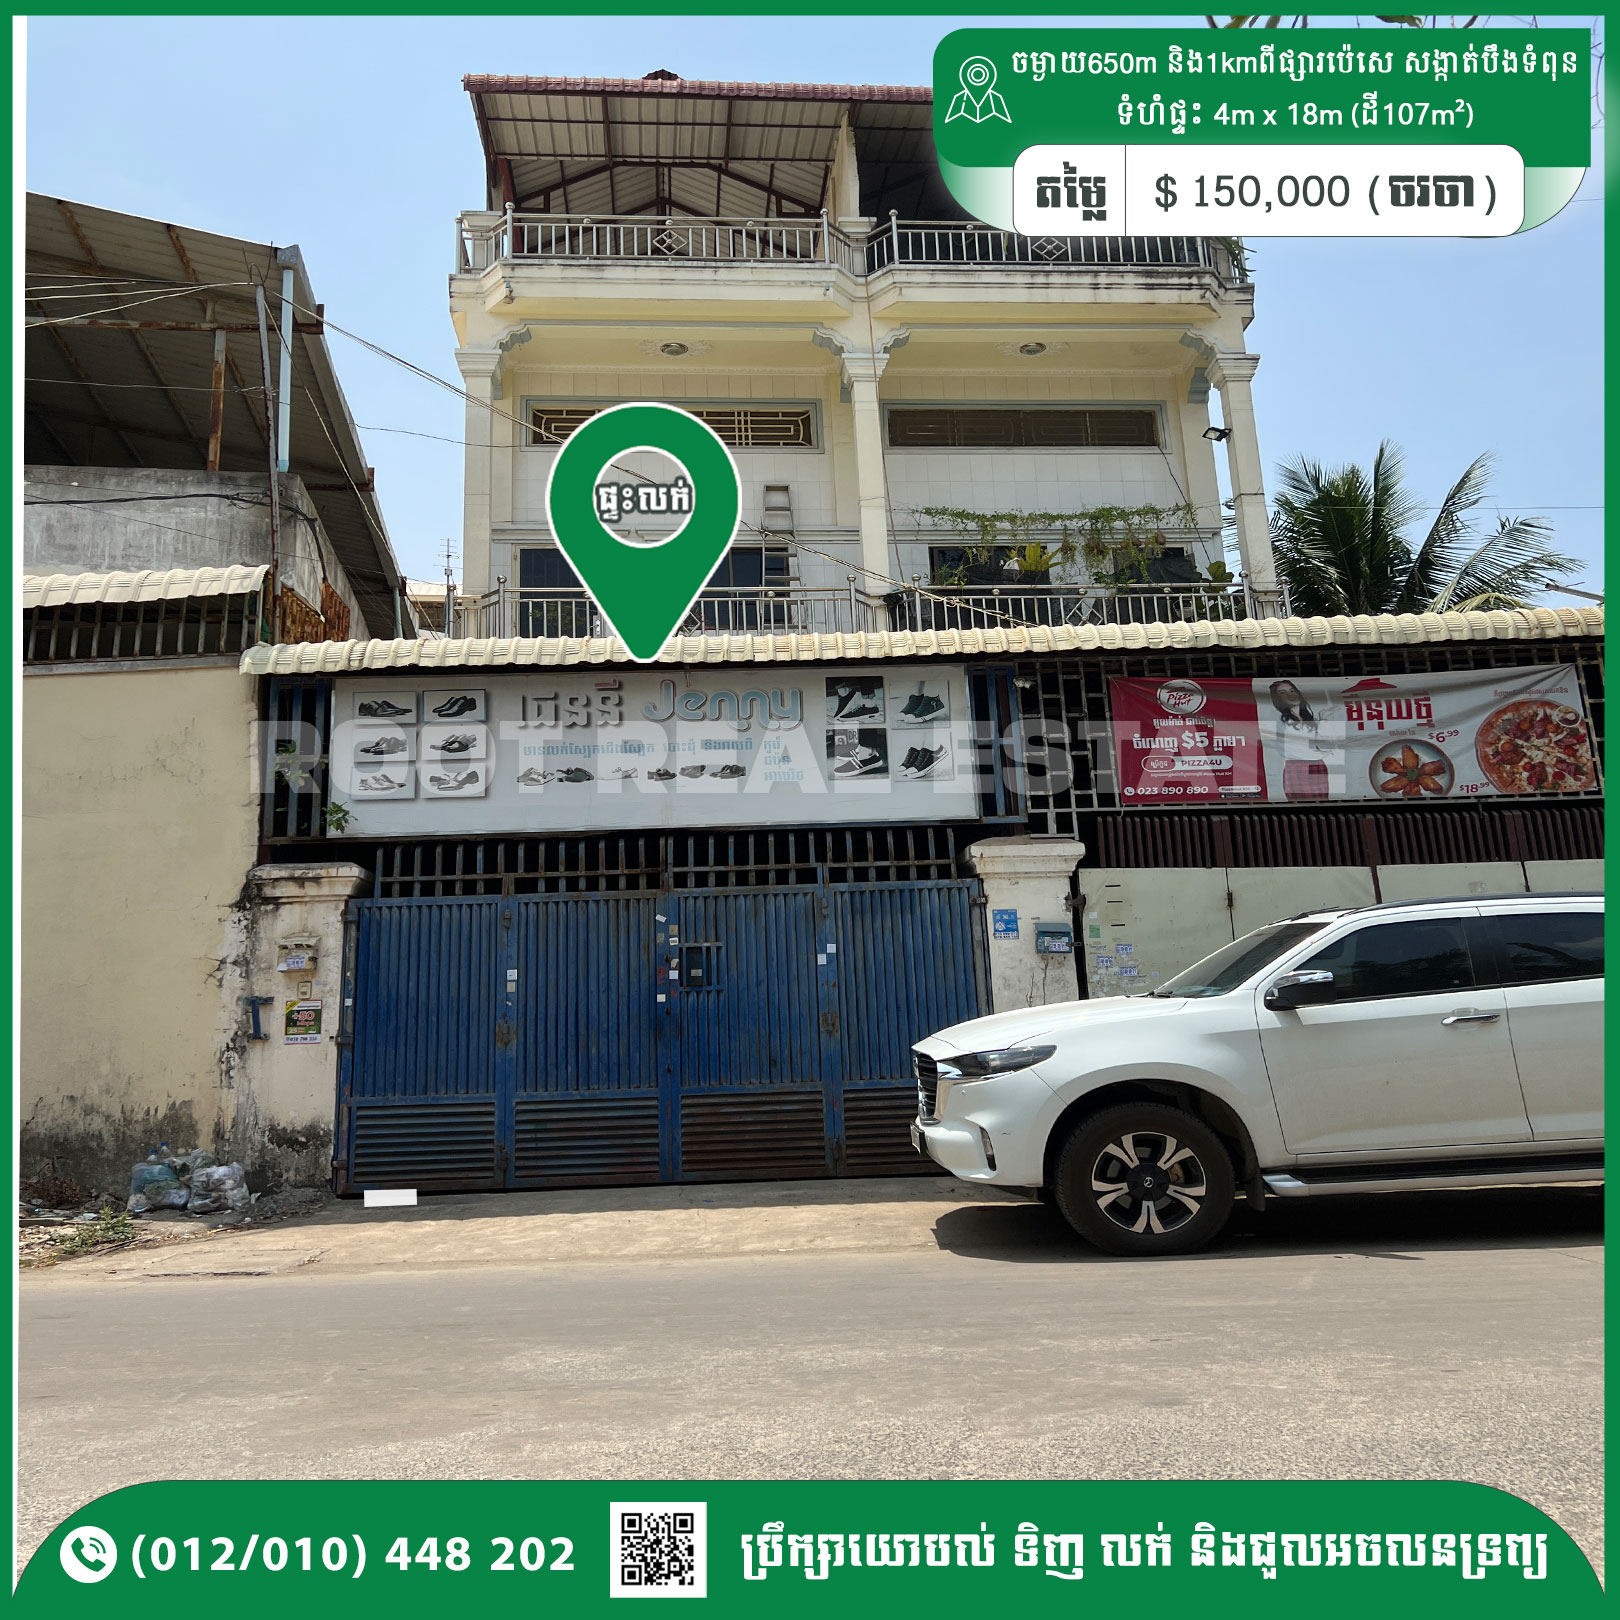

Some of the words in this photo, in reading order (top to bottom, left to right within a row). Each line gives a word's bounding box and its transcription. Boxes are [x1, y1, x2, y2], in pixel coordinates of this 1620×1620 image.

[1166, 691, 1194, 703] Pizza
[1173, 698, 1193, 708] Hut
[643, 679, 803, 732] Jenny
[1181, 730, 1209, 750] $5
[1428, 729, 1460, 743] $6.99
[1181, 759, 1222, 767] PIZZA4U
[1137, 787, 1158, 796] 023
[1161, 786, 1184, 795] 890
[1186, 786, 1208, 795] 890
[1459, 781, 1490, 794] $18.99
